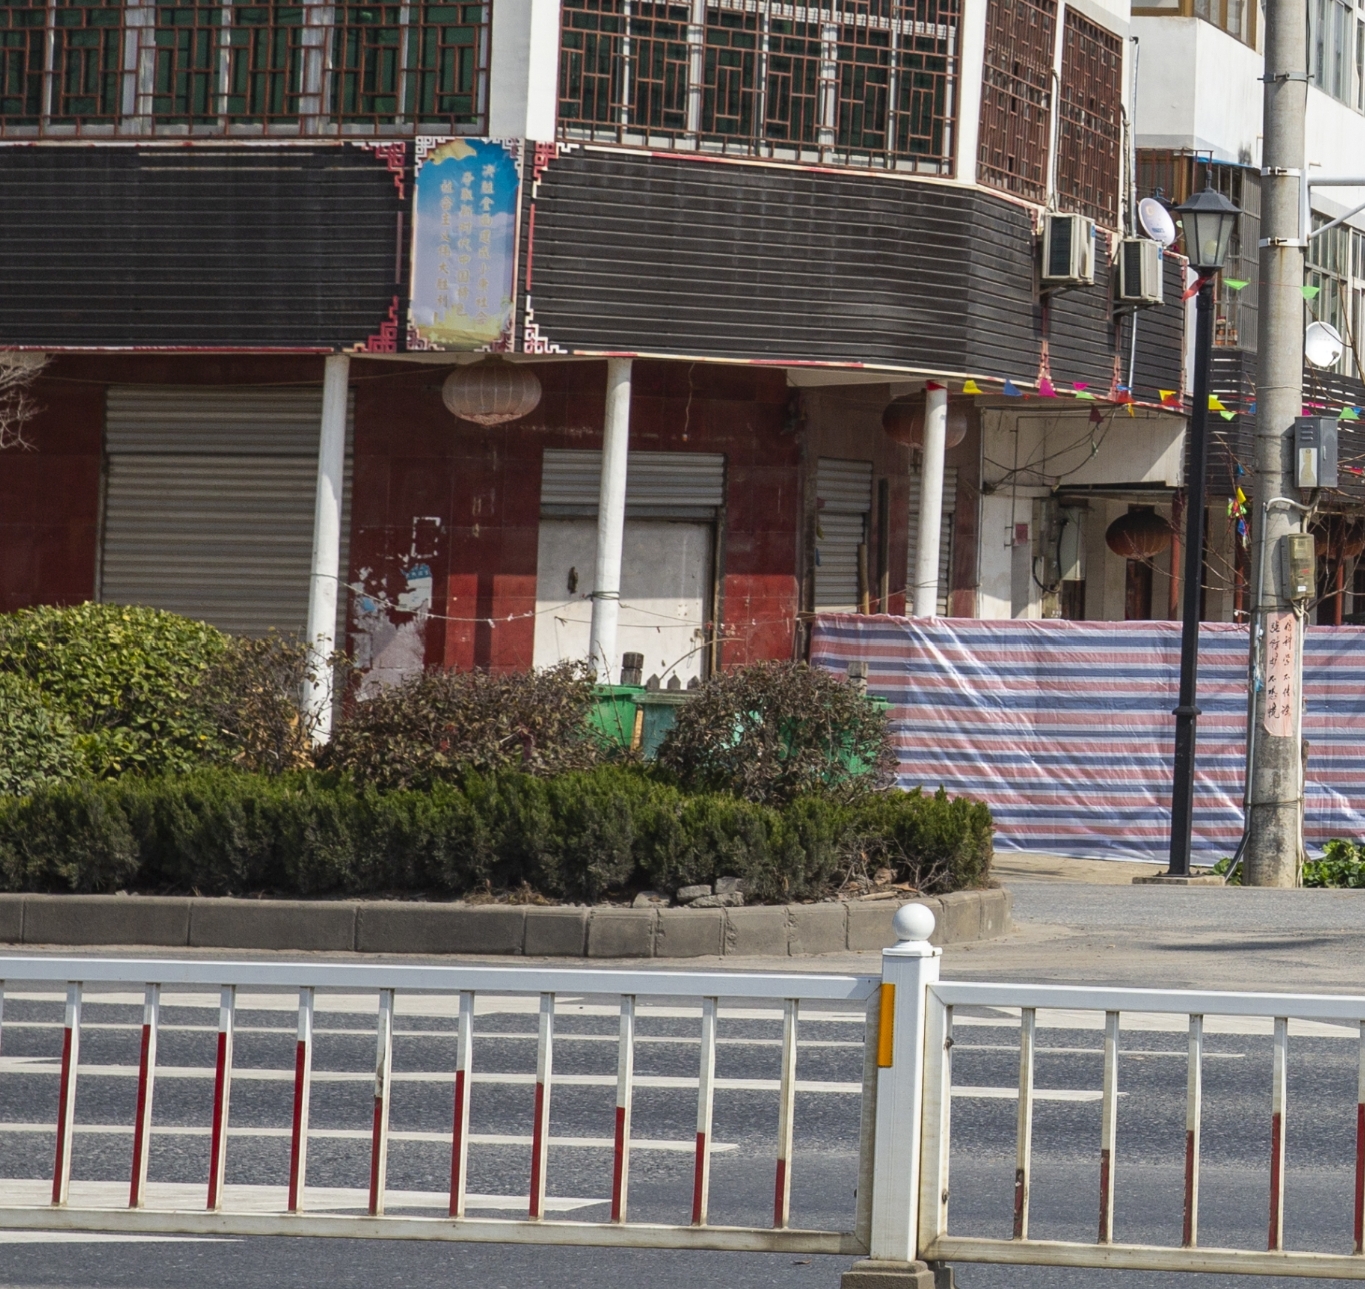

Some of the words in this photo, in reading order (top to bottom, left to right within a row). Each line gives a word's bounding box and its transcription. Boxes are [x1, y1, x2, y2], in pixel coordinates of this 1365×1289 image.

[437, 179, 454, 308] 社会主义伟大胜利
